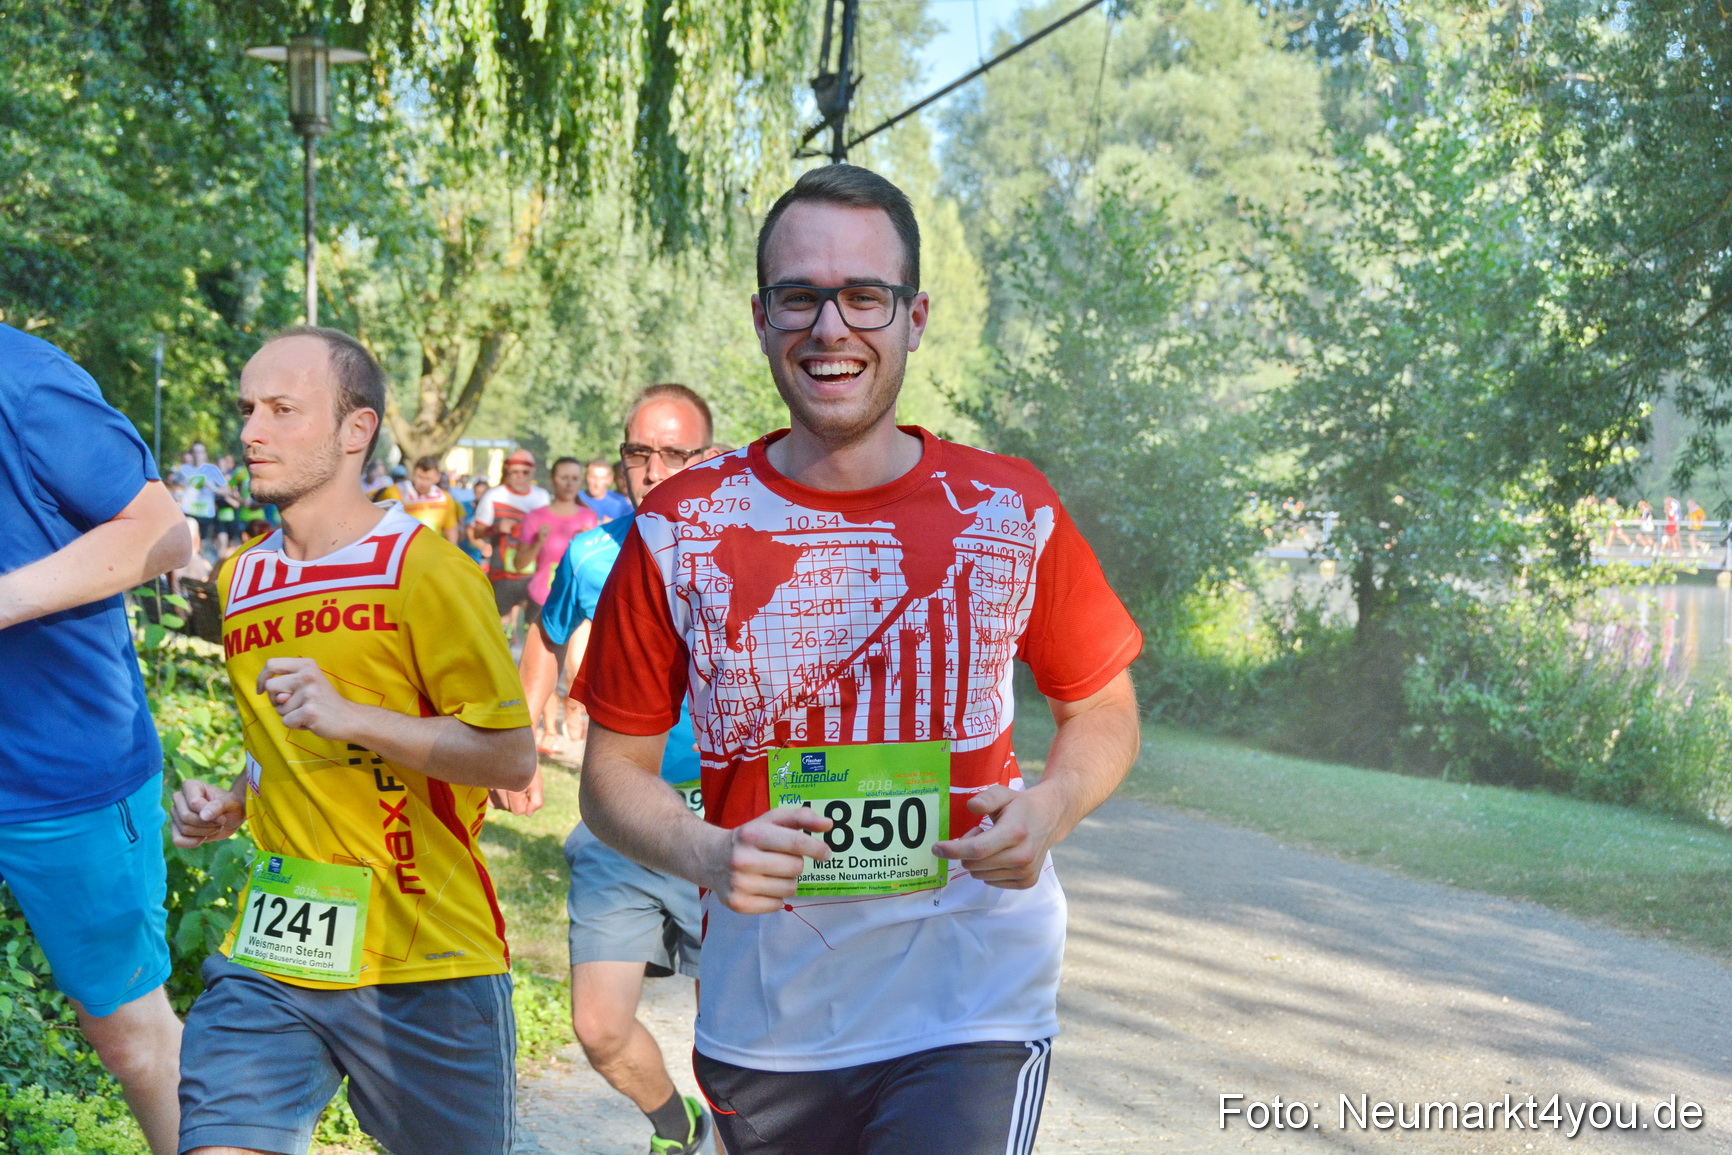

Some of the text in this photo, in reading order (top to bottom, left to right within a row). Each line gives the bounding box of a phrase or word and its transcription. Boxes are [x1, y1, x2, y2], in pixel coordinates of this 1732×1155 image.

[785, 514, 840, 531] 10.54
[974, 517, 1036, 541] 91.62%
[787, 568, 844, 588] 24.87
[224, 598, 399, 661] MAX BÖGL
[791, 628, 849, 650] 26.22
[857, 779, 893, 792] 2018
[848, 855, 908, 869] Dominic
[795, 867, 929, 883] parkasse Neumarkt-Parsberg
[253, 893, 338, 947] 1241
[248, 935, 332, 960] Weismann Stefan
[269, 950, 307, 966] Bauservice
[309, 959, 334, 969] GmbH
